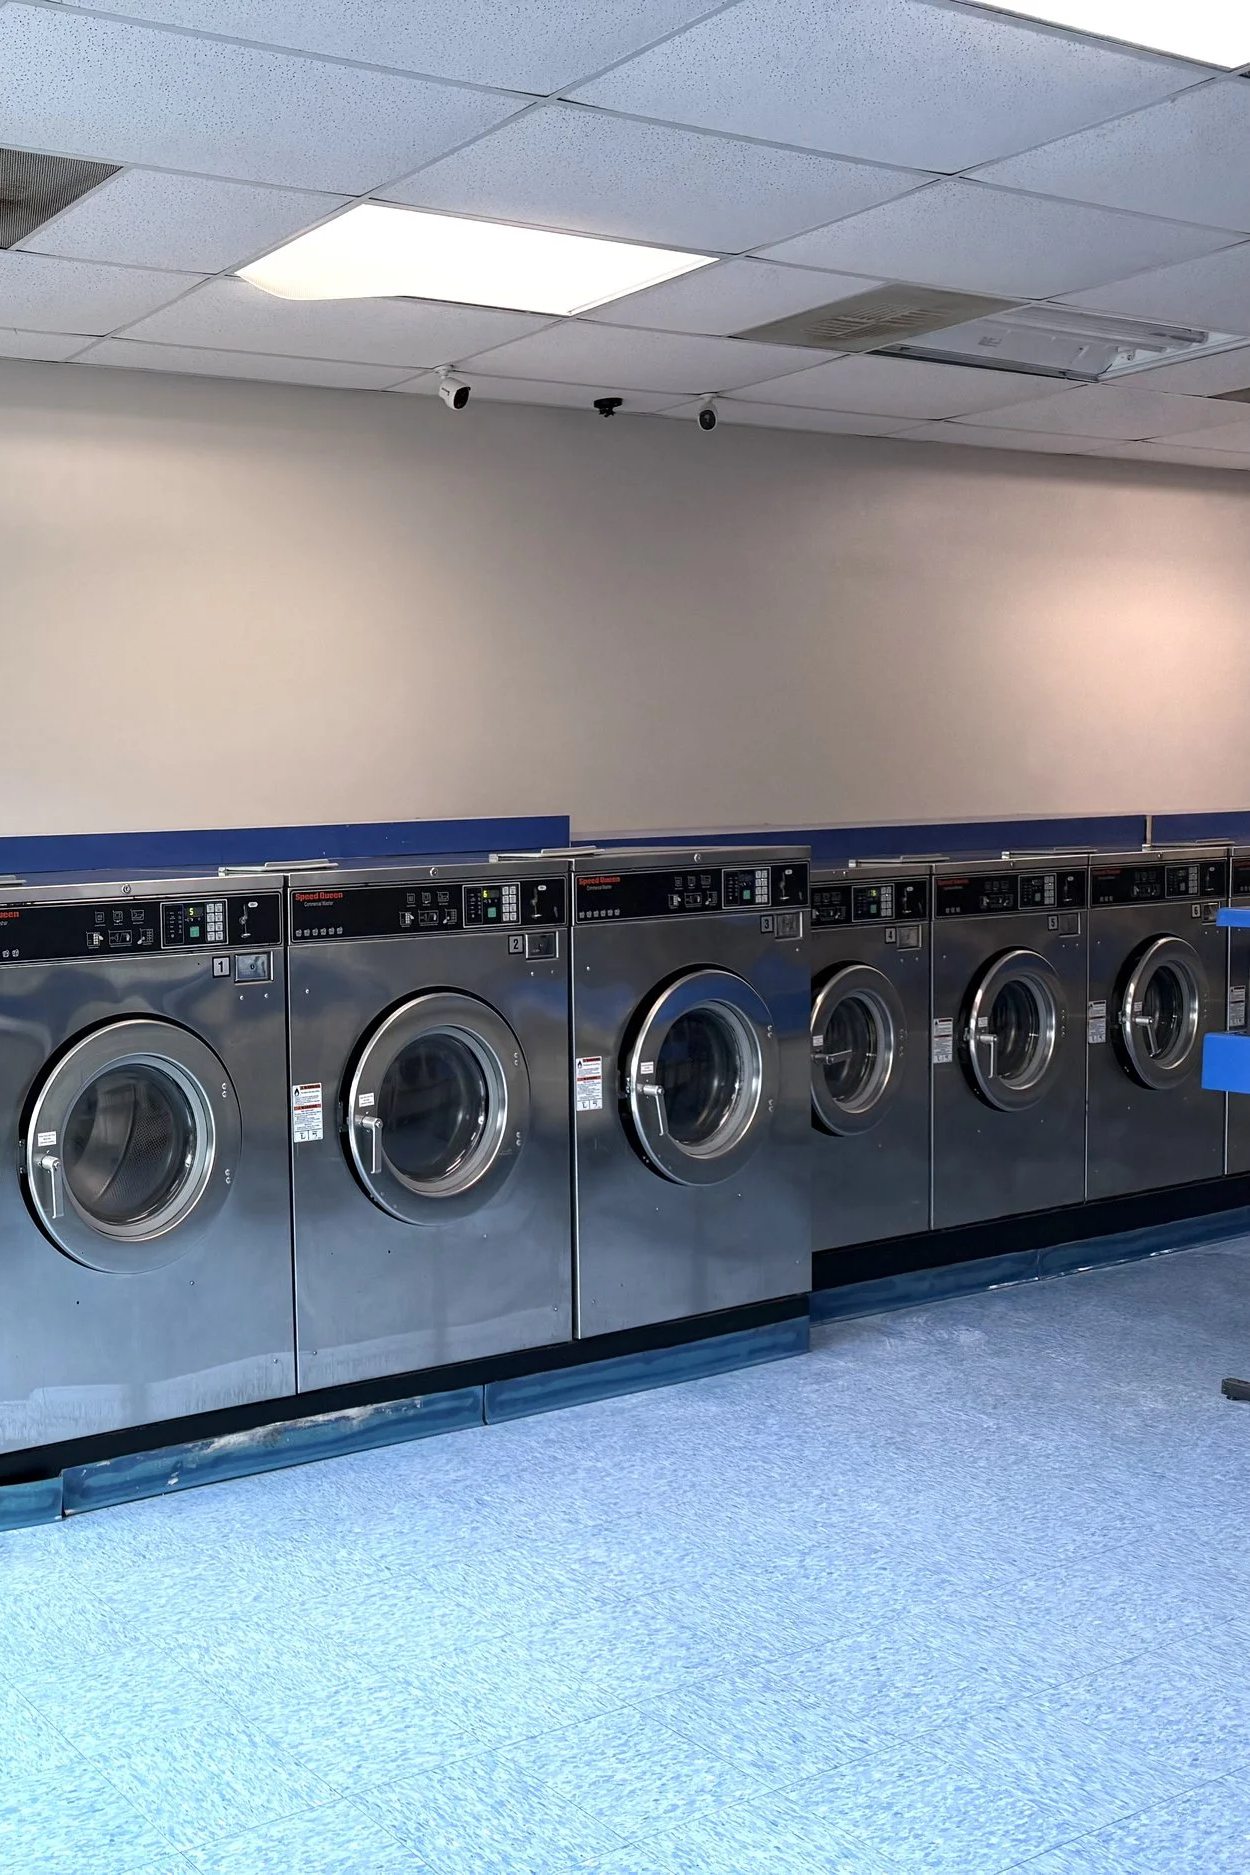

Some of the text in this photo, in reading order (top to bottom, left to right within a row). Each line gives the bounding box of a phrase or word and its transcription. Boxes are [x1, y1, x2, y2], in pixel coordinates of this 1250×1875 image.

[295, 892, 318, 901] Speed
[764, 919, 770, 929] 3
[513, 938, 518, 949] 2
[218, 961, 223, 973] 1
